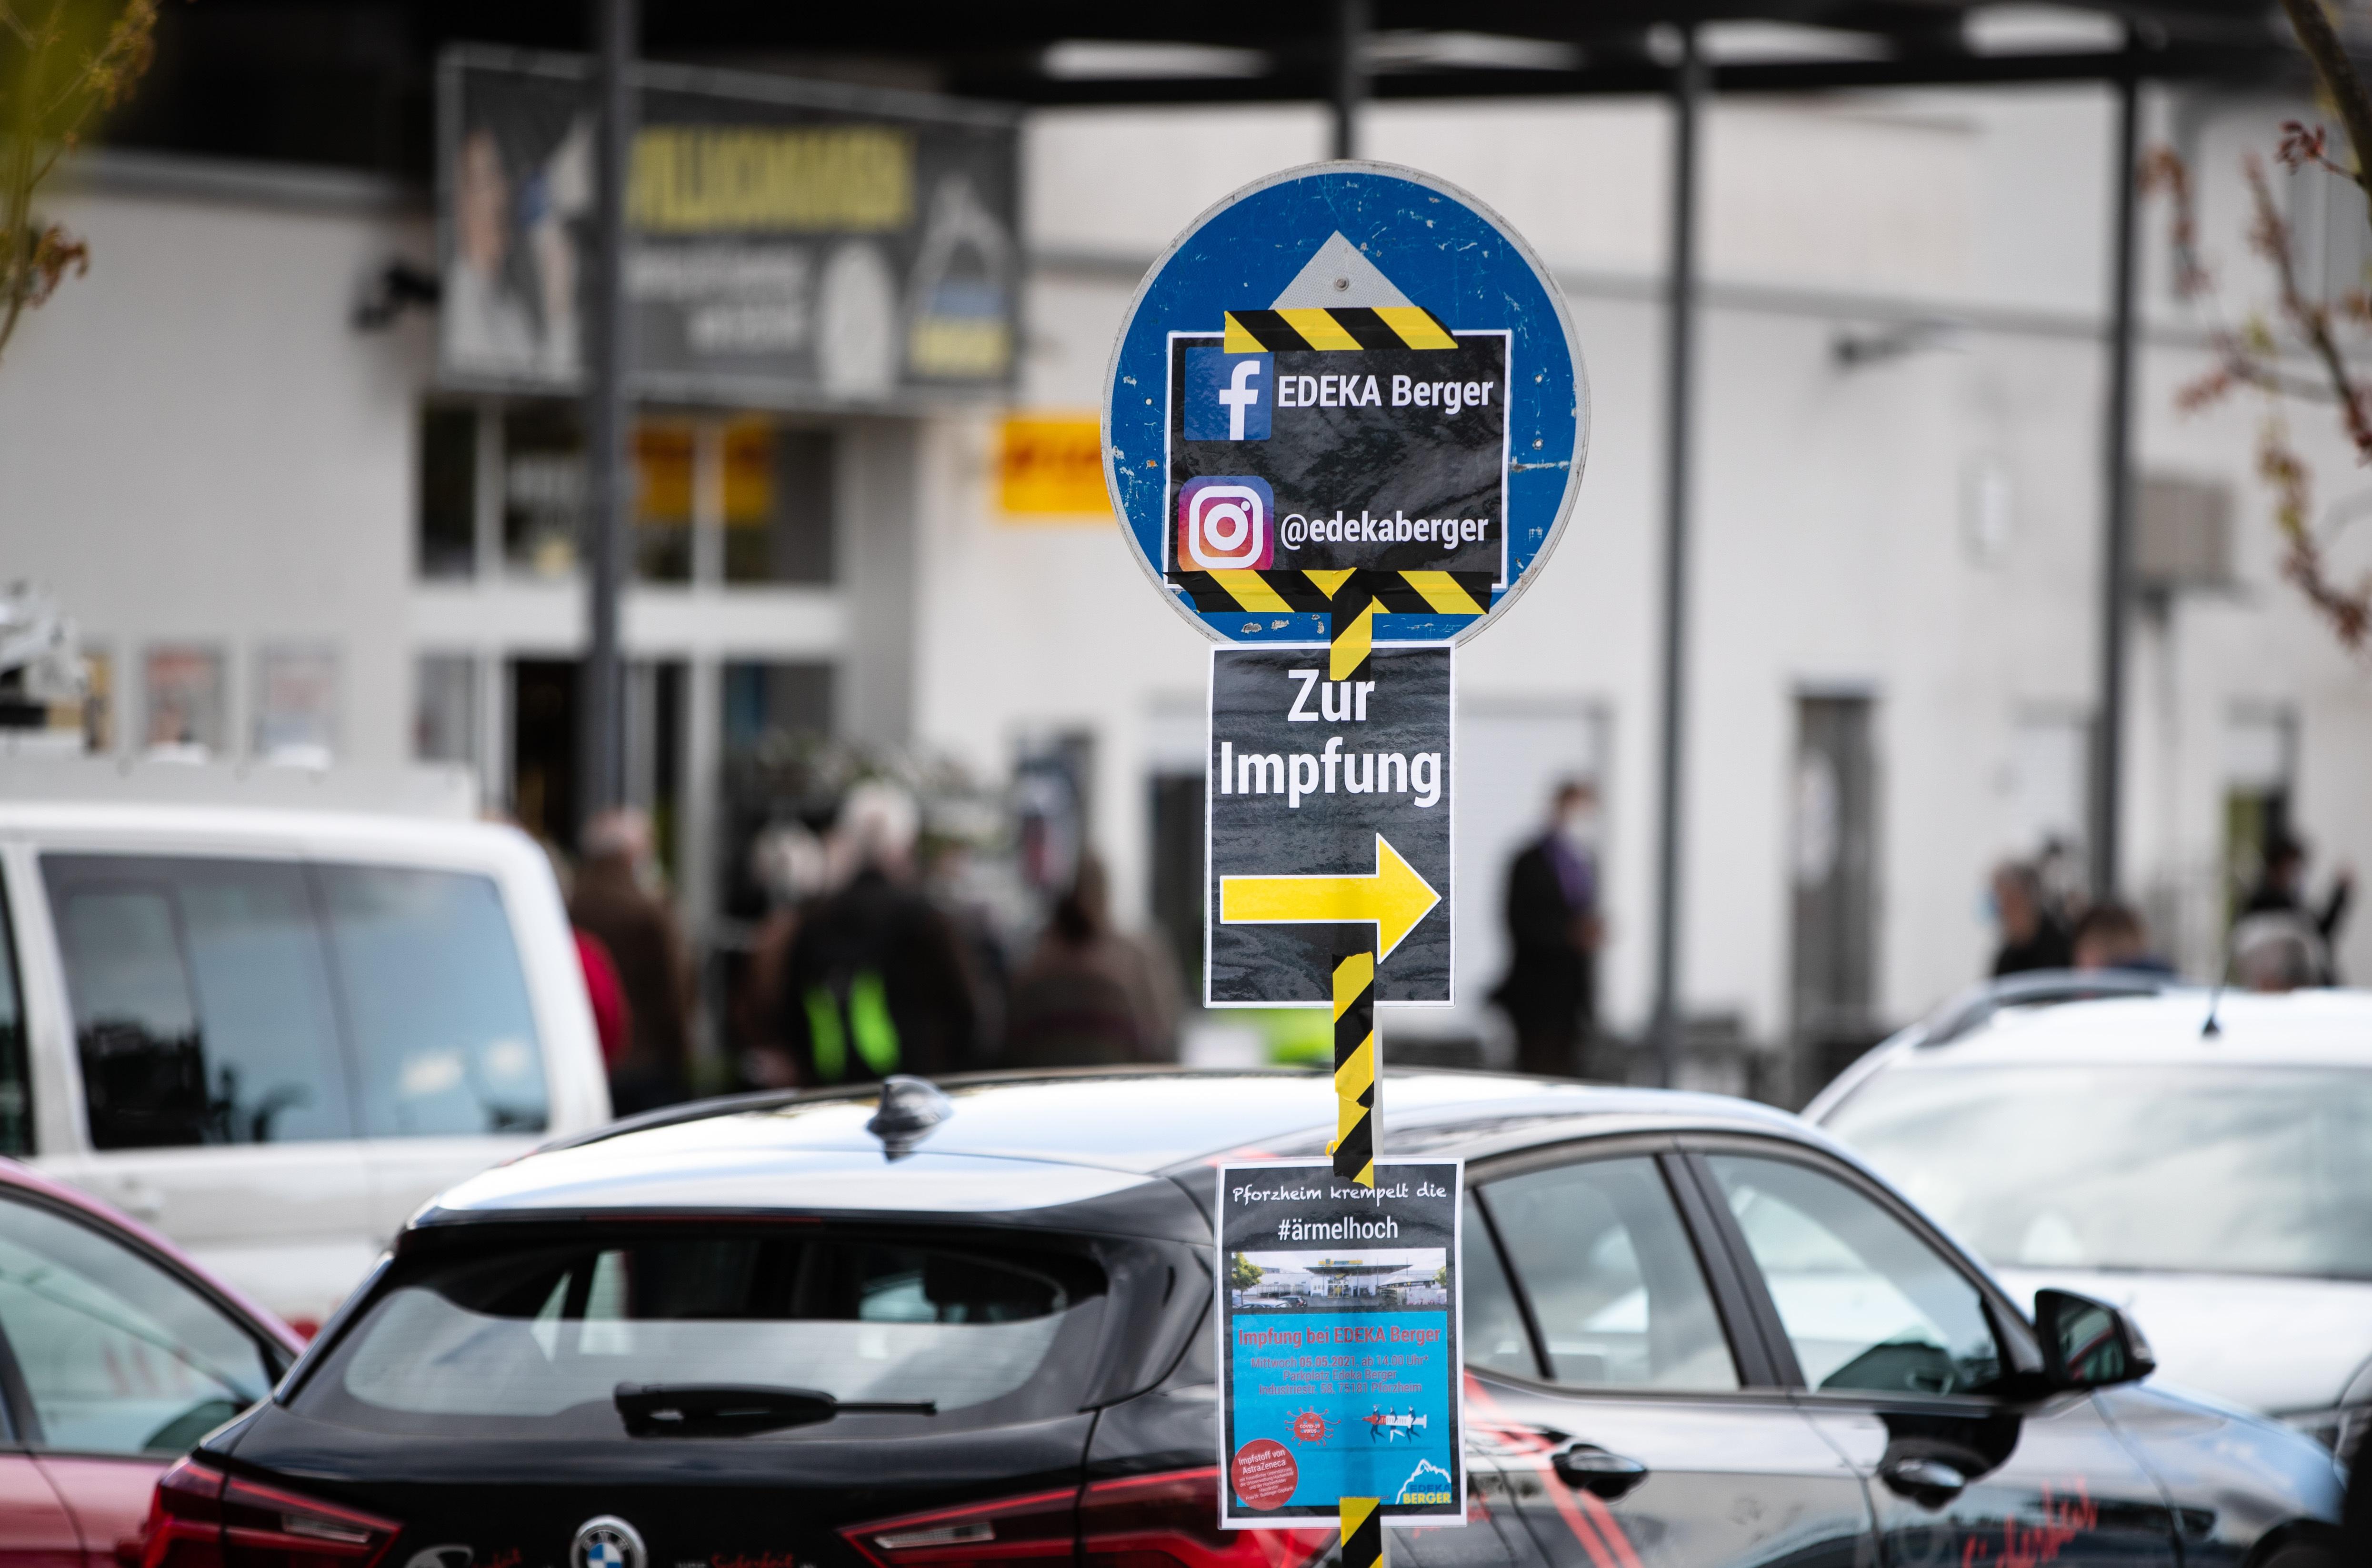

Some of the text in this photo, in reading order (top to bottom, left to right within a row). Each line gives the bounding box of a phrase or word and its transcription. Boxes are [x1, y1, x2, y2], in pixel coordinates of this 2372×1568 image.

[1278, 375, 1382, 408] EDEKA
[1391, 374, 1494, 415] Berger
[1281, 510, 1489, 550] @edekaberger
[1288, 669, 1375, 722] Zur
[1221, 737, 1441, 808] Impfung
[1232, 1181, 1447, 1207] Pforzheim krempelt die
[1278, 1216, 1398, 1240] #ärmelhoch
[1239, 1326, 1441, 1349] Impfung bei EDEKA Berger
[1251, 1357, 1297, 1368] Mittwoch
[1299, 1355, 1359, 1368] 05.05.2021,
[1361, 1356, 1373, 1367] ab
[1377, 1355, 1403, 1367] 14.00
[1283, 1369, 1397, 1383] Parkplatz Edeka Berger
[1259, 1382, 1422, 1395] Industriestr. 58, 75181 Pforzheim
[1238, 1450, 1285, 1466] Impfstoff von
[1242, 1459, 1286, 1475] AstraZeneca
[1403, 1492, 1451, 1504] BERGER
[1410, 1484, 1451, 1493] EDEKA
